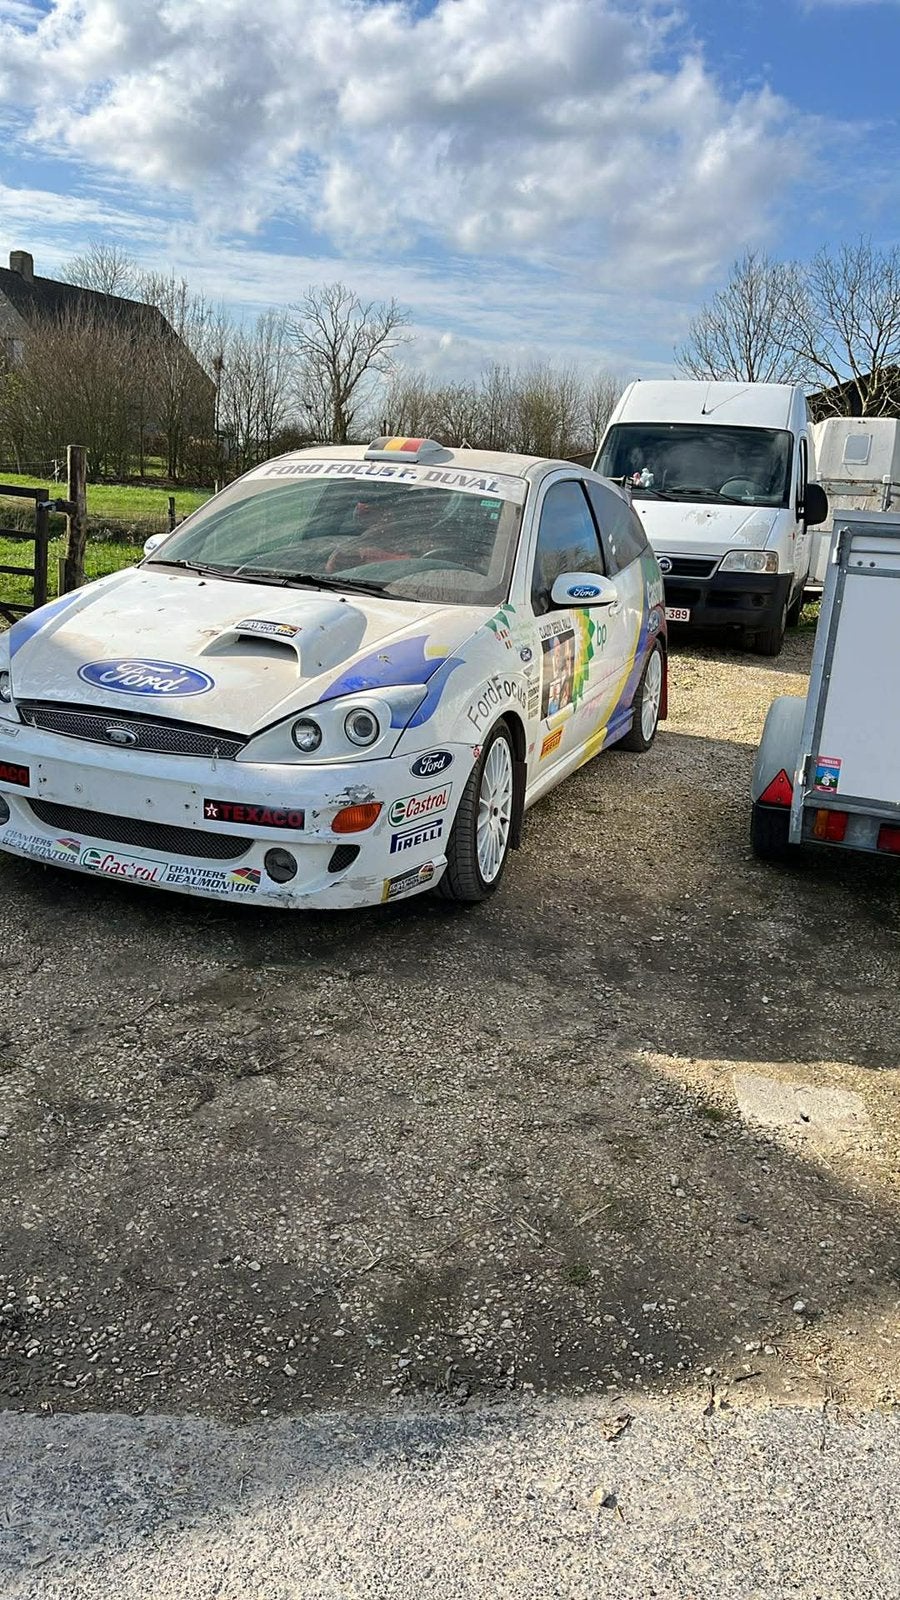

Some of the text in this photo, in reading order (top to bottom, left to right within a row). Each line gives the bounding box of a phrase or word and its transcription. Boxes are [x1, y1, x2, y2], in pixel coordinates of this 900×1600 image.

[264, 464, 322, 476] FORD
[323, 464, 399, 477] FOCUS
[399, 467, 417, 479] F.
[423, 470, 500, 493] DUVAL
[573, 586, 597, 597] Ford
[596, 620, 607, 651] bp
[100, 662, 189, 693] Ford
[0, 763, 28, 785] ACO
[419, 753, 446, 774] Ford
[220, 804, 303, 827] TEXACO
[405, 789, 447, 818] Castrol
[389, 818, 444, 855] PIRELLI
[169, 864, 227, 880] CHANTIERS
